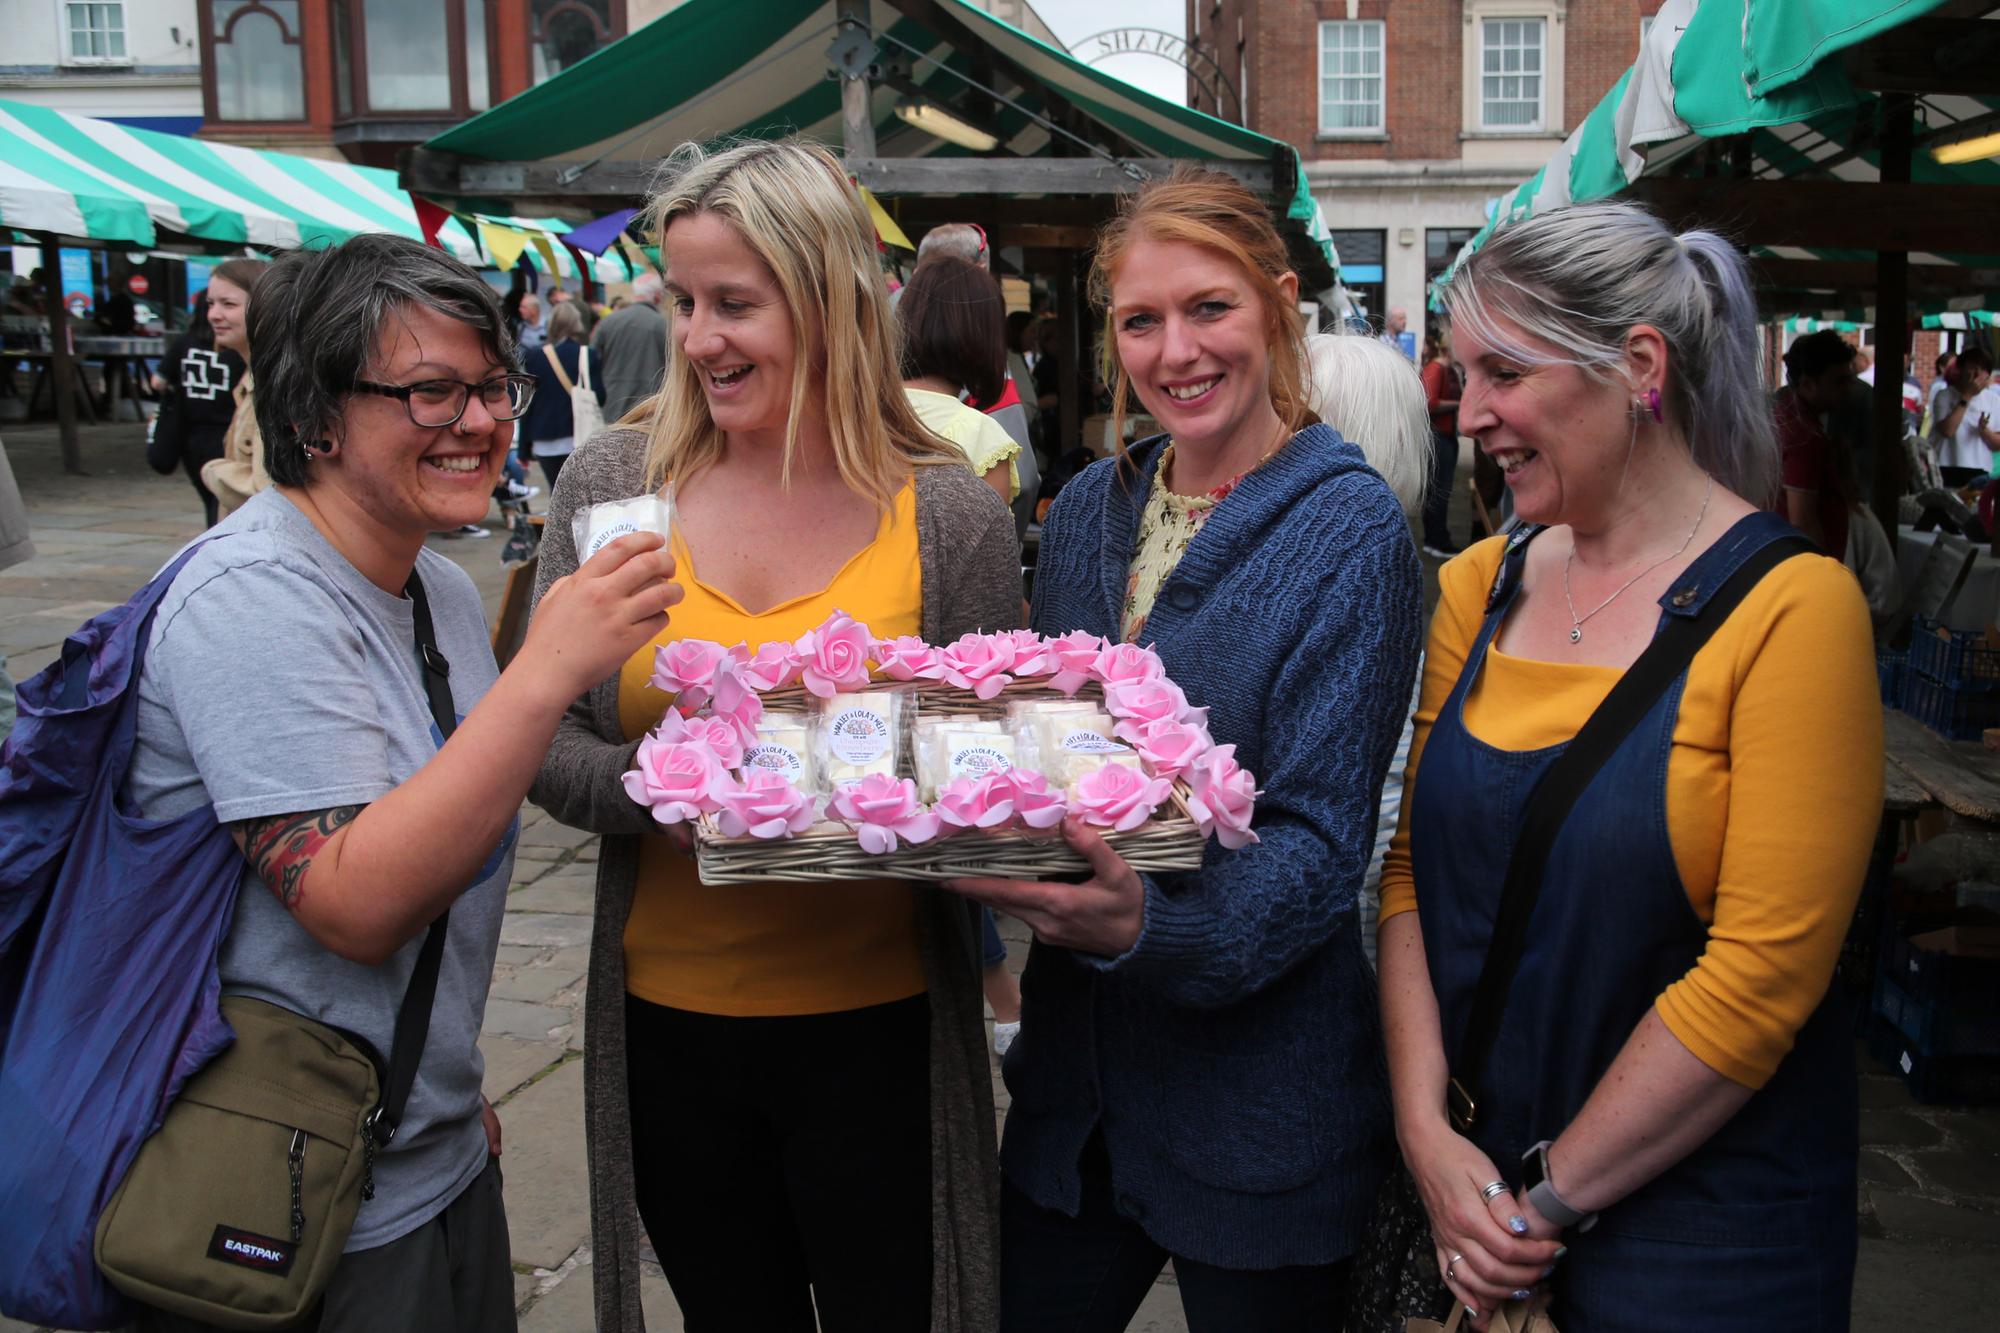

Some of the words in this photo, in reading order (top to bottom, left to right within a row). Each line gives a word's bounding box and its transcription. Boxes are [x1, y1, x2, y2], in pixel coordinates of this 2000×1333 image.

[833, 713, 850, 736] HARRIET
[854, 710, 874, 721] LOLA'S
[874, 718, 887, 737] MELTS
[766, 746, 787, 756] LOLA'S
[787, 753, 800, 769] MELTS
[224, 1239, 281, 1262] EASTPAK
